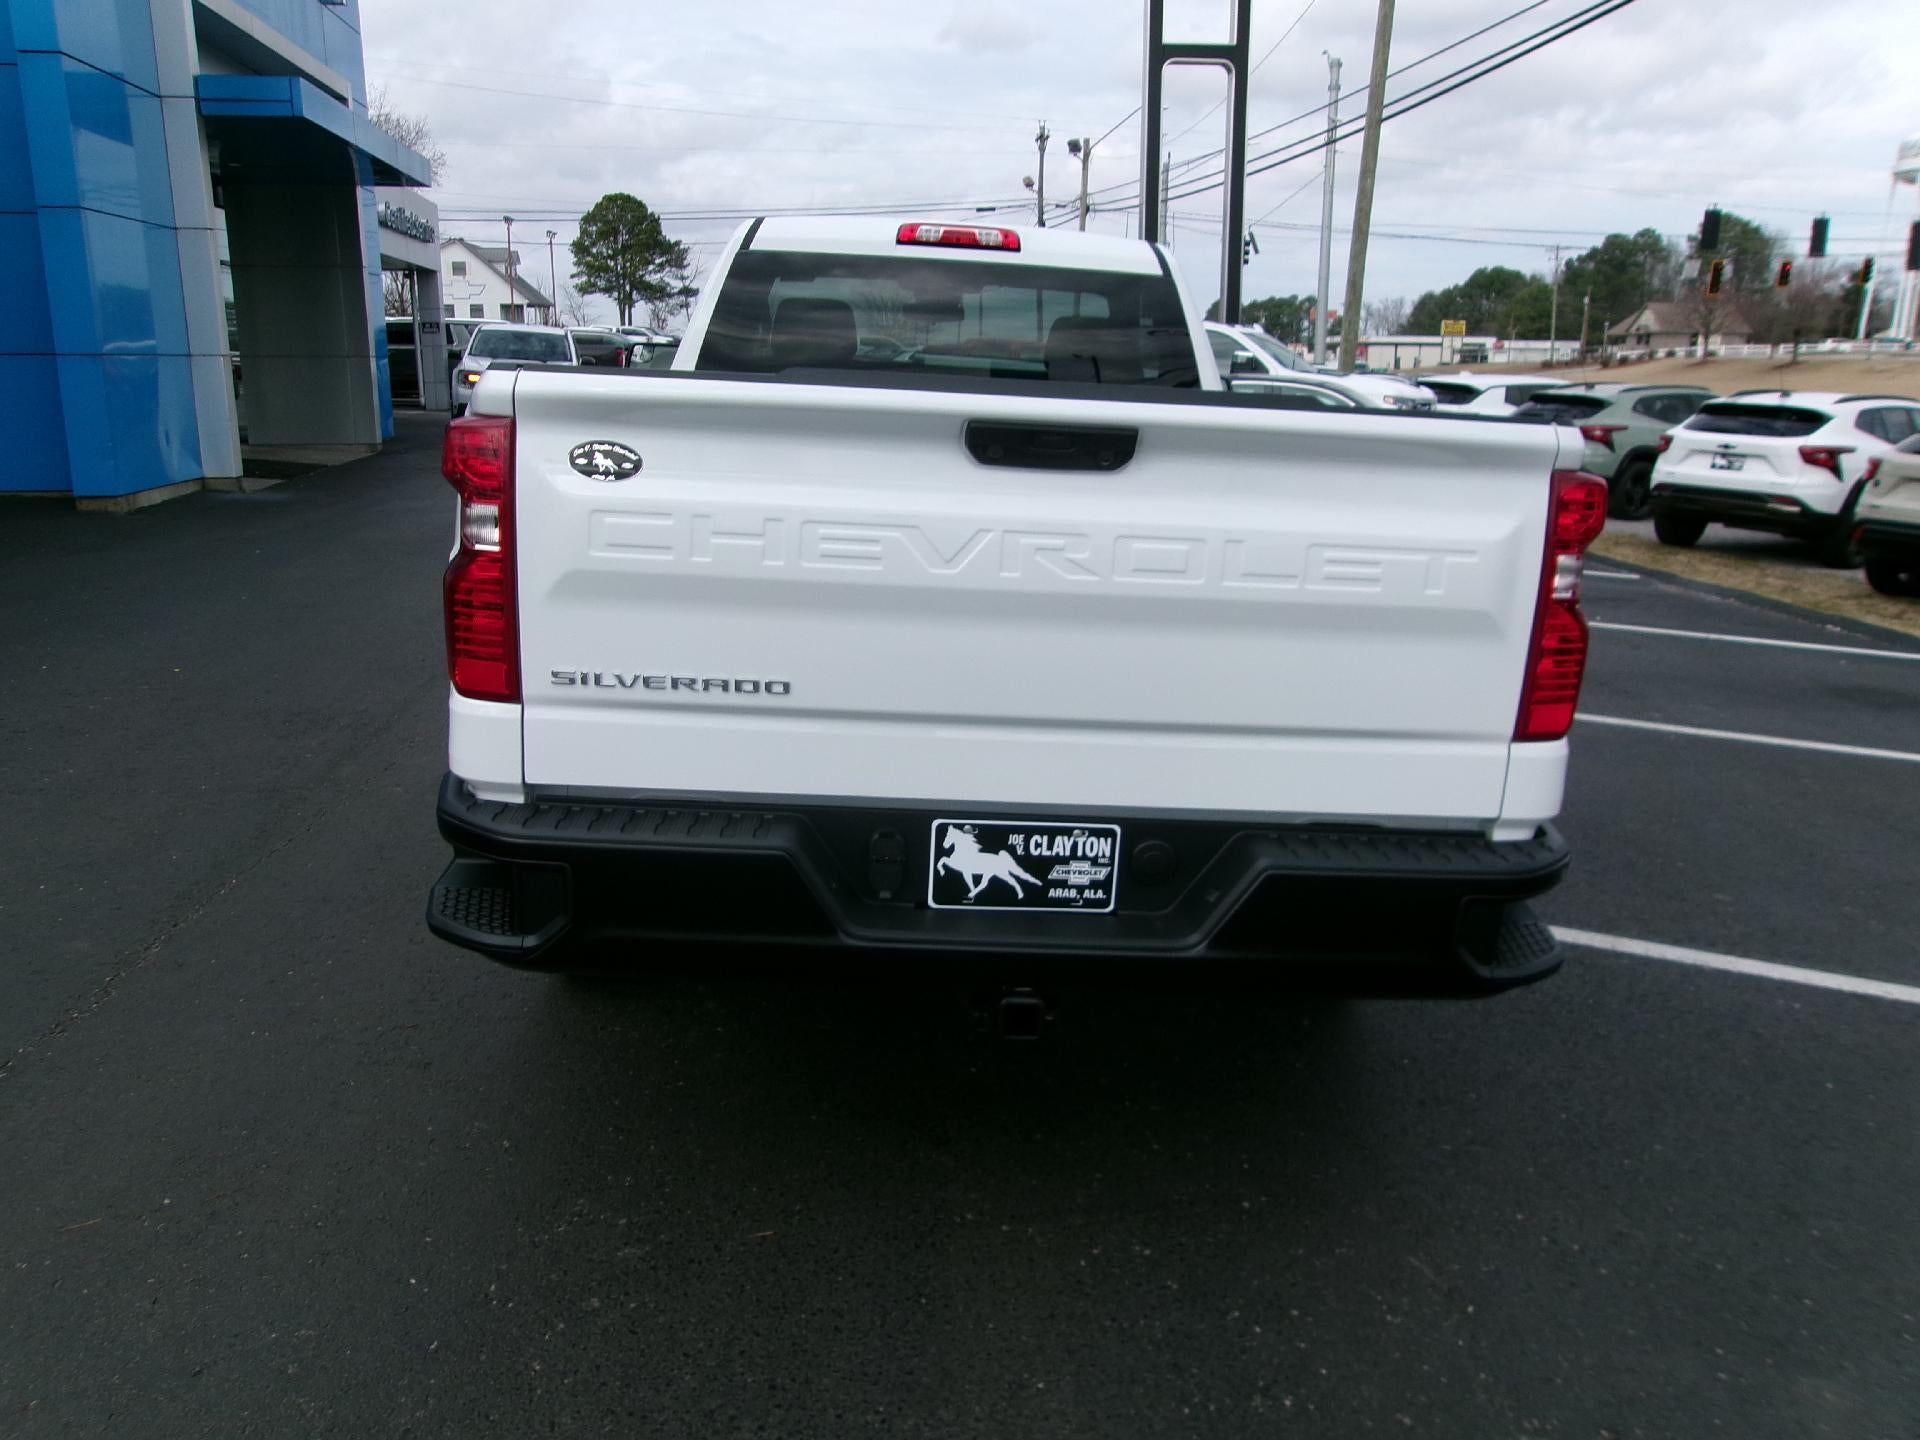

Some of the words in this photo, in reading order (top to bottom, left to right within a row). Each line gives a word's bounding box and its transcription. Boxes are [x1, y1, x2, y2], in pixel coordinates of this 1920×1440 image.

[588, 508, 1479, 596] CHEVROLET
[550, 670, 791, 695] SILVERADO
[1008, 833, 1025, 845] JOE
[1016, 844, 1025, 855] V.
[1029, 834, 1112, 857] CLAYTON
[1056, 868, 1103, 876] CHEVROLET
[1048, 887, 1081, 899] ARAB,
[1083, 888, 1107, 899] ALA.
